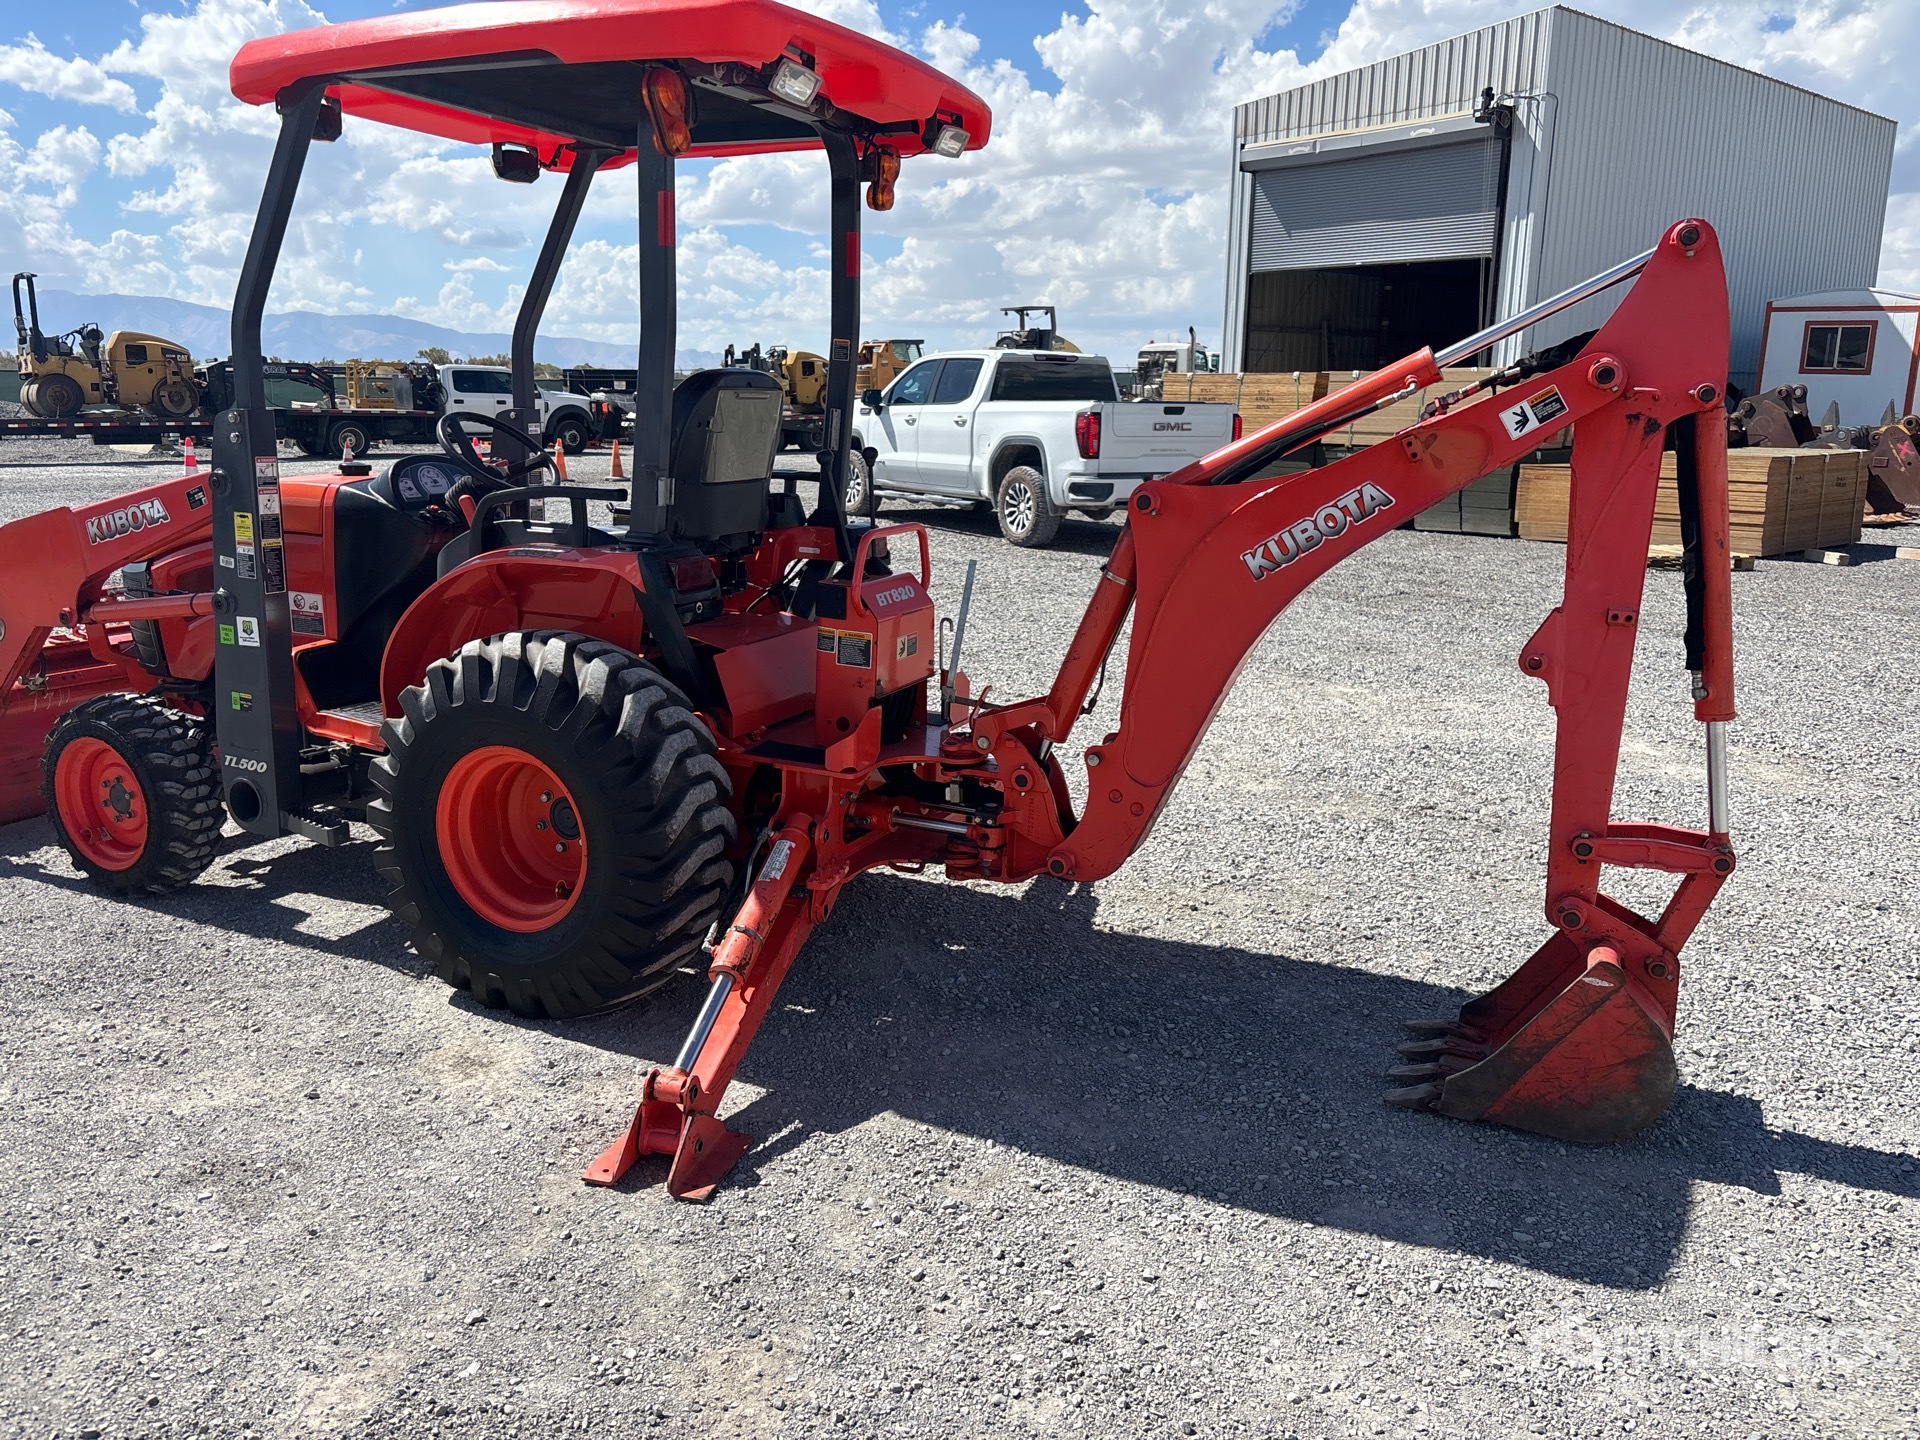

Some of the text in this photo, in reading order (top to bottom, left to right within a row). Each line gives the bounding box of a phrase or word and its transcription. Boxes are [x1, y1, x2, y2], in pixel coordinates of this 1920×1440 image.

[1152, 422, 1192, 431] GMC
[86, 498, 169, 544] KUBOTA
[1242, 482, 1394, 581] KUBOTA
[875, 584, 915, 607] BT820
[224, 754, 268, 773] TL500
